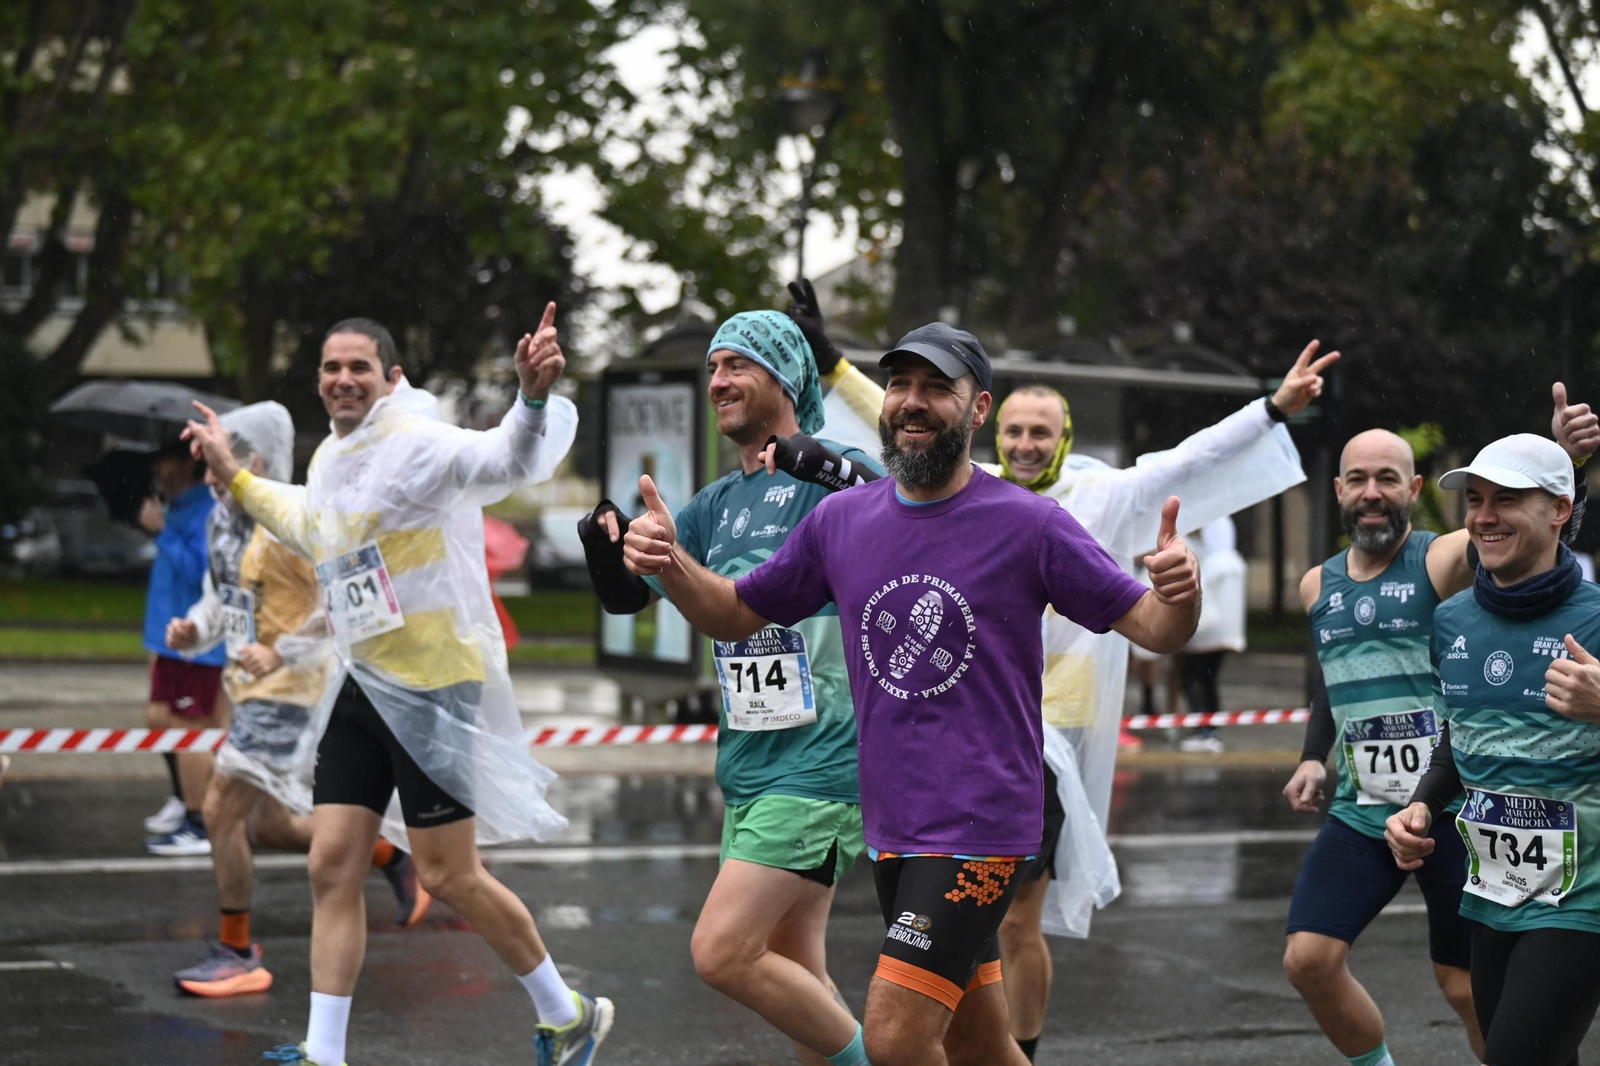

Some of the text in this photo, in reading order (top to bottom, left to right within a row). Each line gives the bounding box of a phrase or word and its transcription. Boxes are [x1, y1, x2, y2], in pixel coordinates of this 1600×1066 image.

[901, 574, 919, 585] DE
[861, 579, 899, 631] POPULAR
[922, 574, 976, 633] PRIMAVERA
[861, 634, 880, 678] CROSS
[964, 643, 976, 660] LA
[1533, 640, 1551, 649] GRAN
[729, 659, 787, 693] 714
[921, 661, 970, 699] RAMBLA
[878, 677, 910, 700] XXXIV
[749, 698, 766, 709] RAÚL
[770, 713, 801, 723] IMDECO
[1364, 744, 1419, 773] 710
[1504, 796, 1546, 810] MEDIA
[1504, 808, 1547, 818] MARATÓN
[1478, 828, 1547, 871] 734
